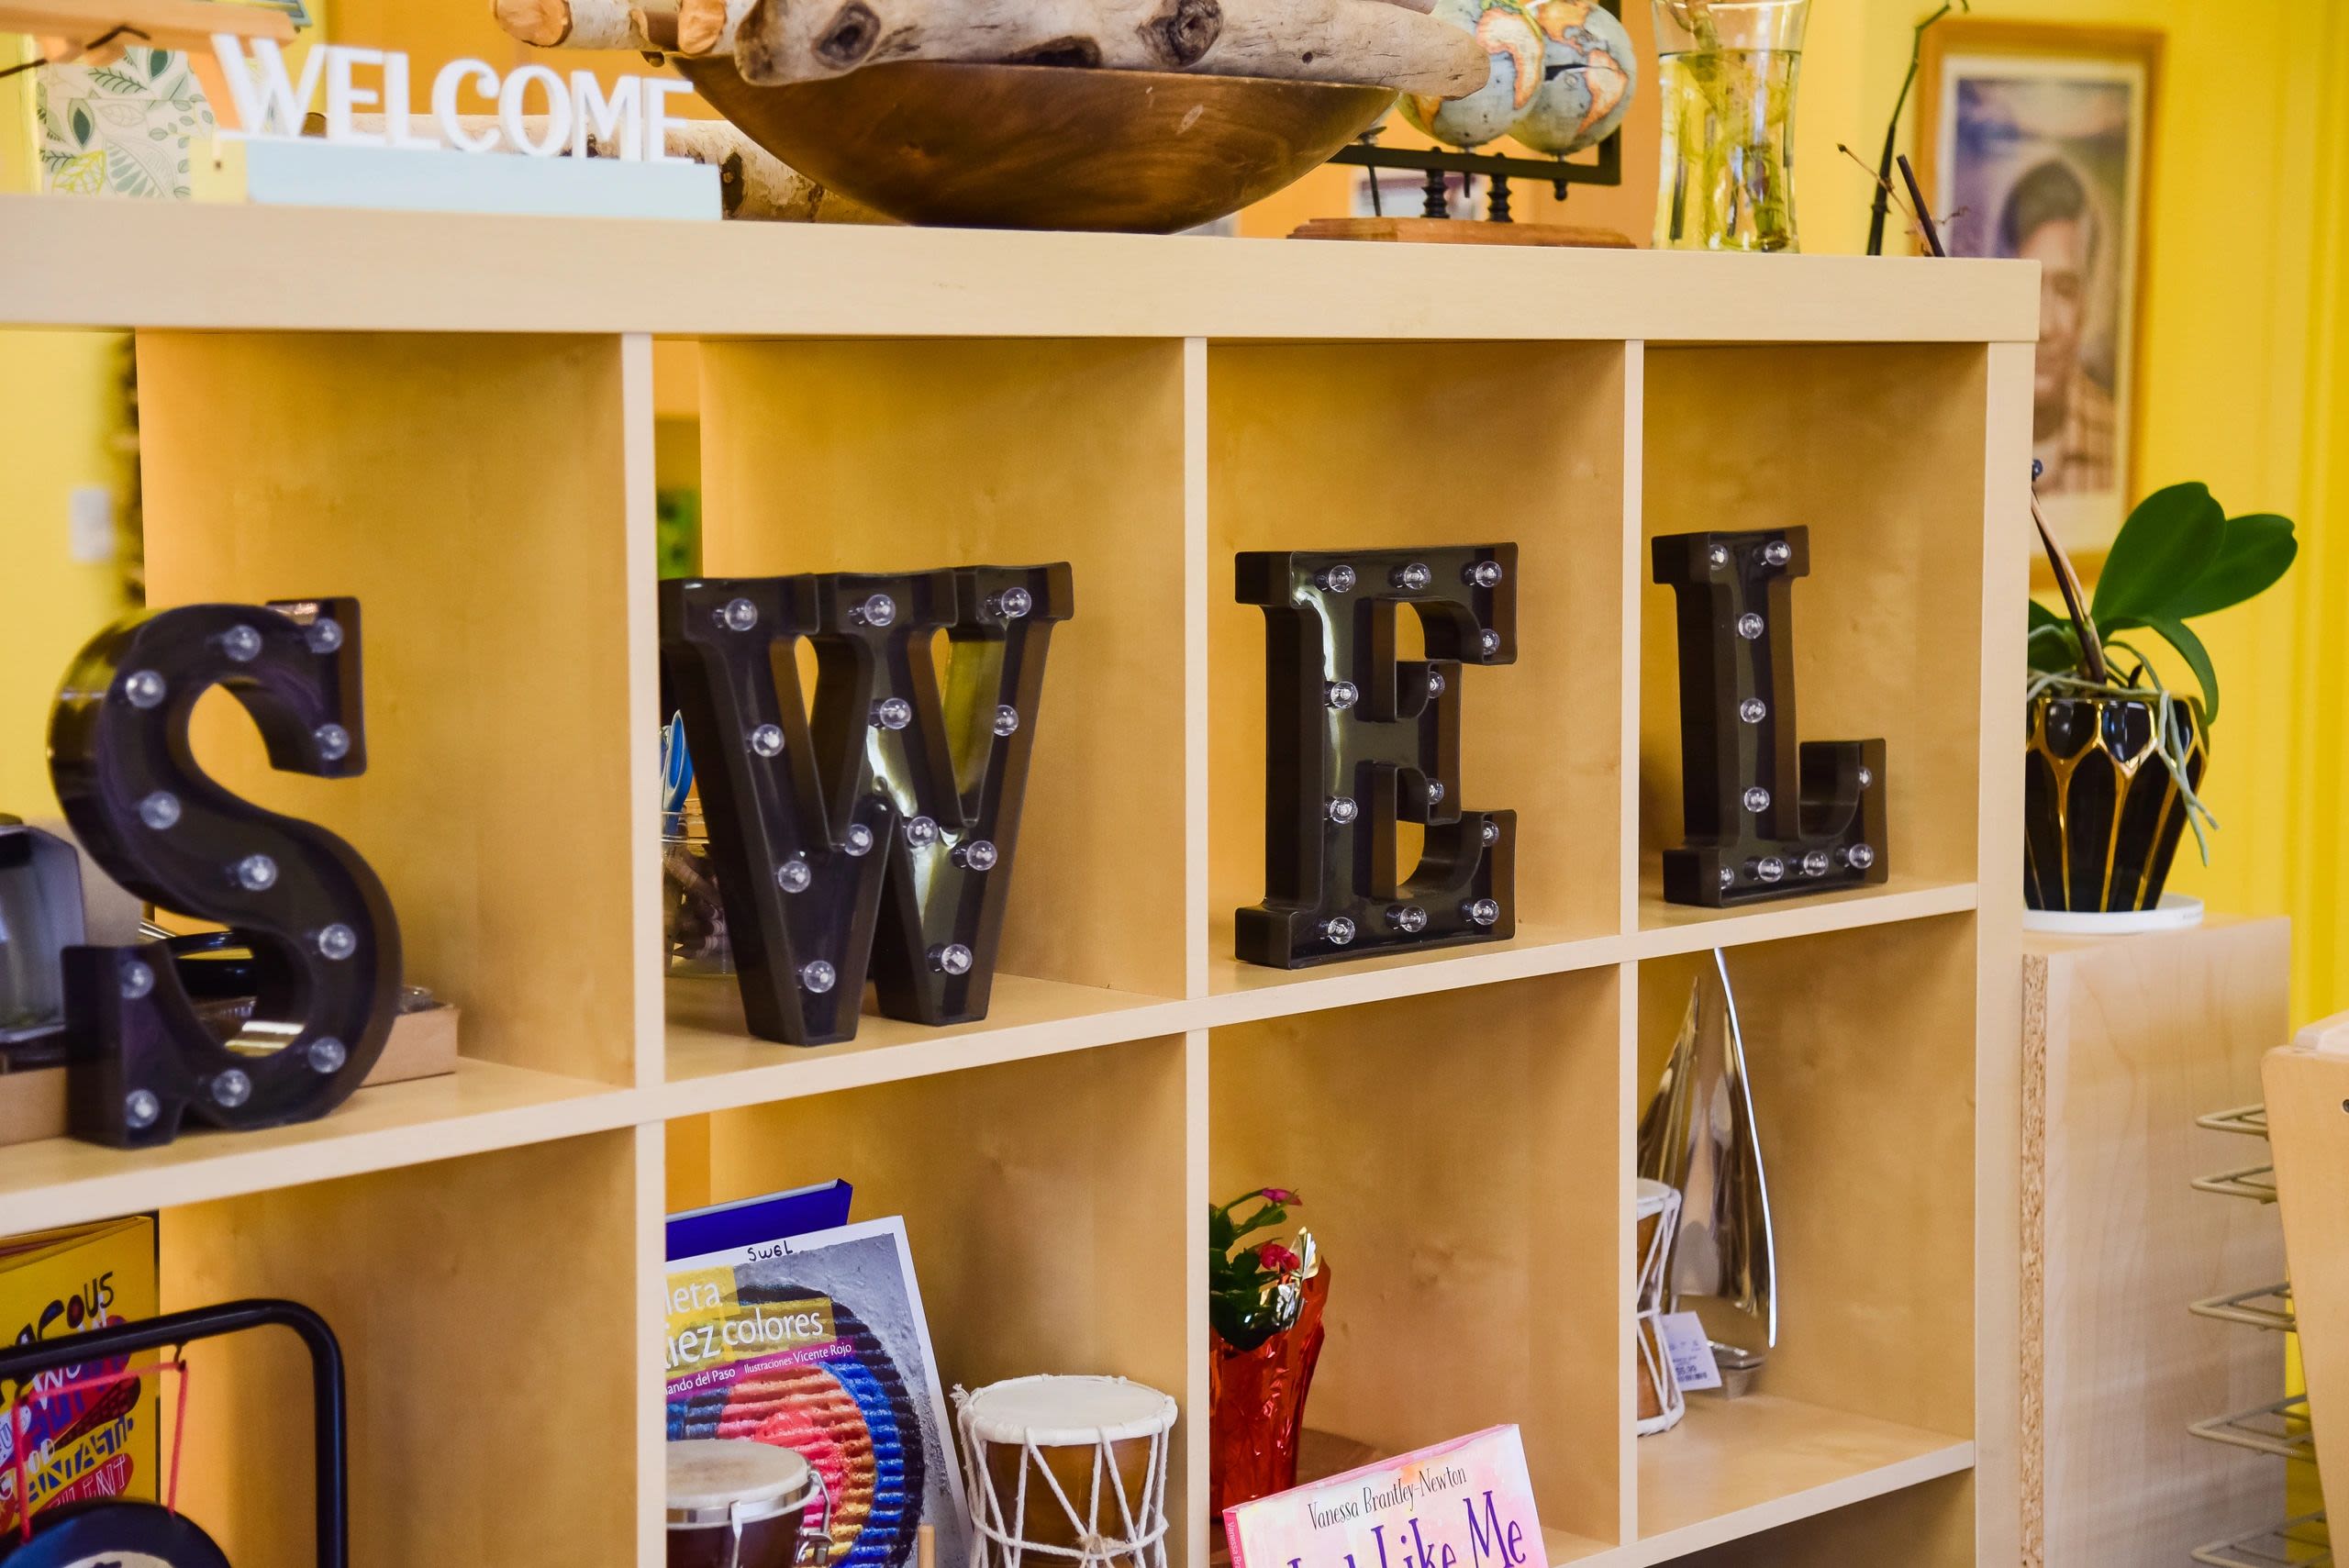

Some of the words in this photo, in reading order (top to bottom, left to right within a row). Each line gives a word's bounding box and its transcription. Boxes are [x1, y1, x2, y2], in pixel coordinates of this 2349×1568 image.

[211, 33, 695, 166] WELCOME
[665, 1278, 721, 1316] leta
[721, 1307, 824, 1347] colores
[793, 1347, 829, 1363] Vicente
[829, 1342, 852, 1360] Rojo
[695, 1372, 711, 1386] del
[711, 1368, 736, 1383] Paso
[1308, 1498, 1360, 1531] Vanessa
[1363, 1465, 1467, 1514] Brantley-Newton
[1463, 1490, 1526, 1568] Me
